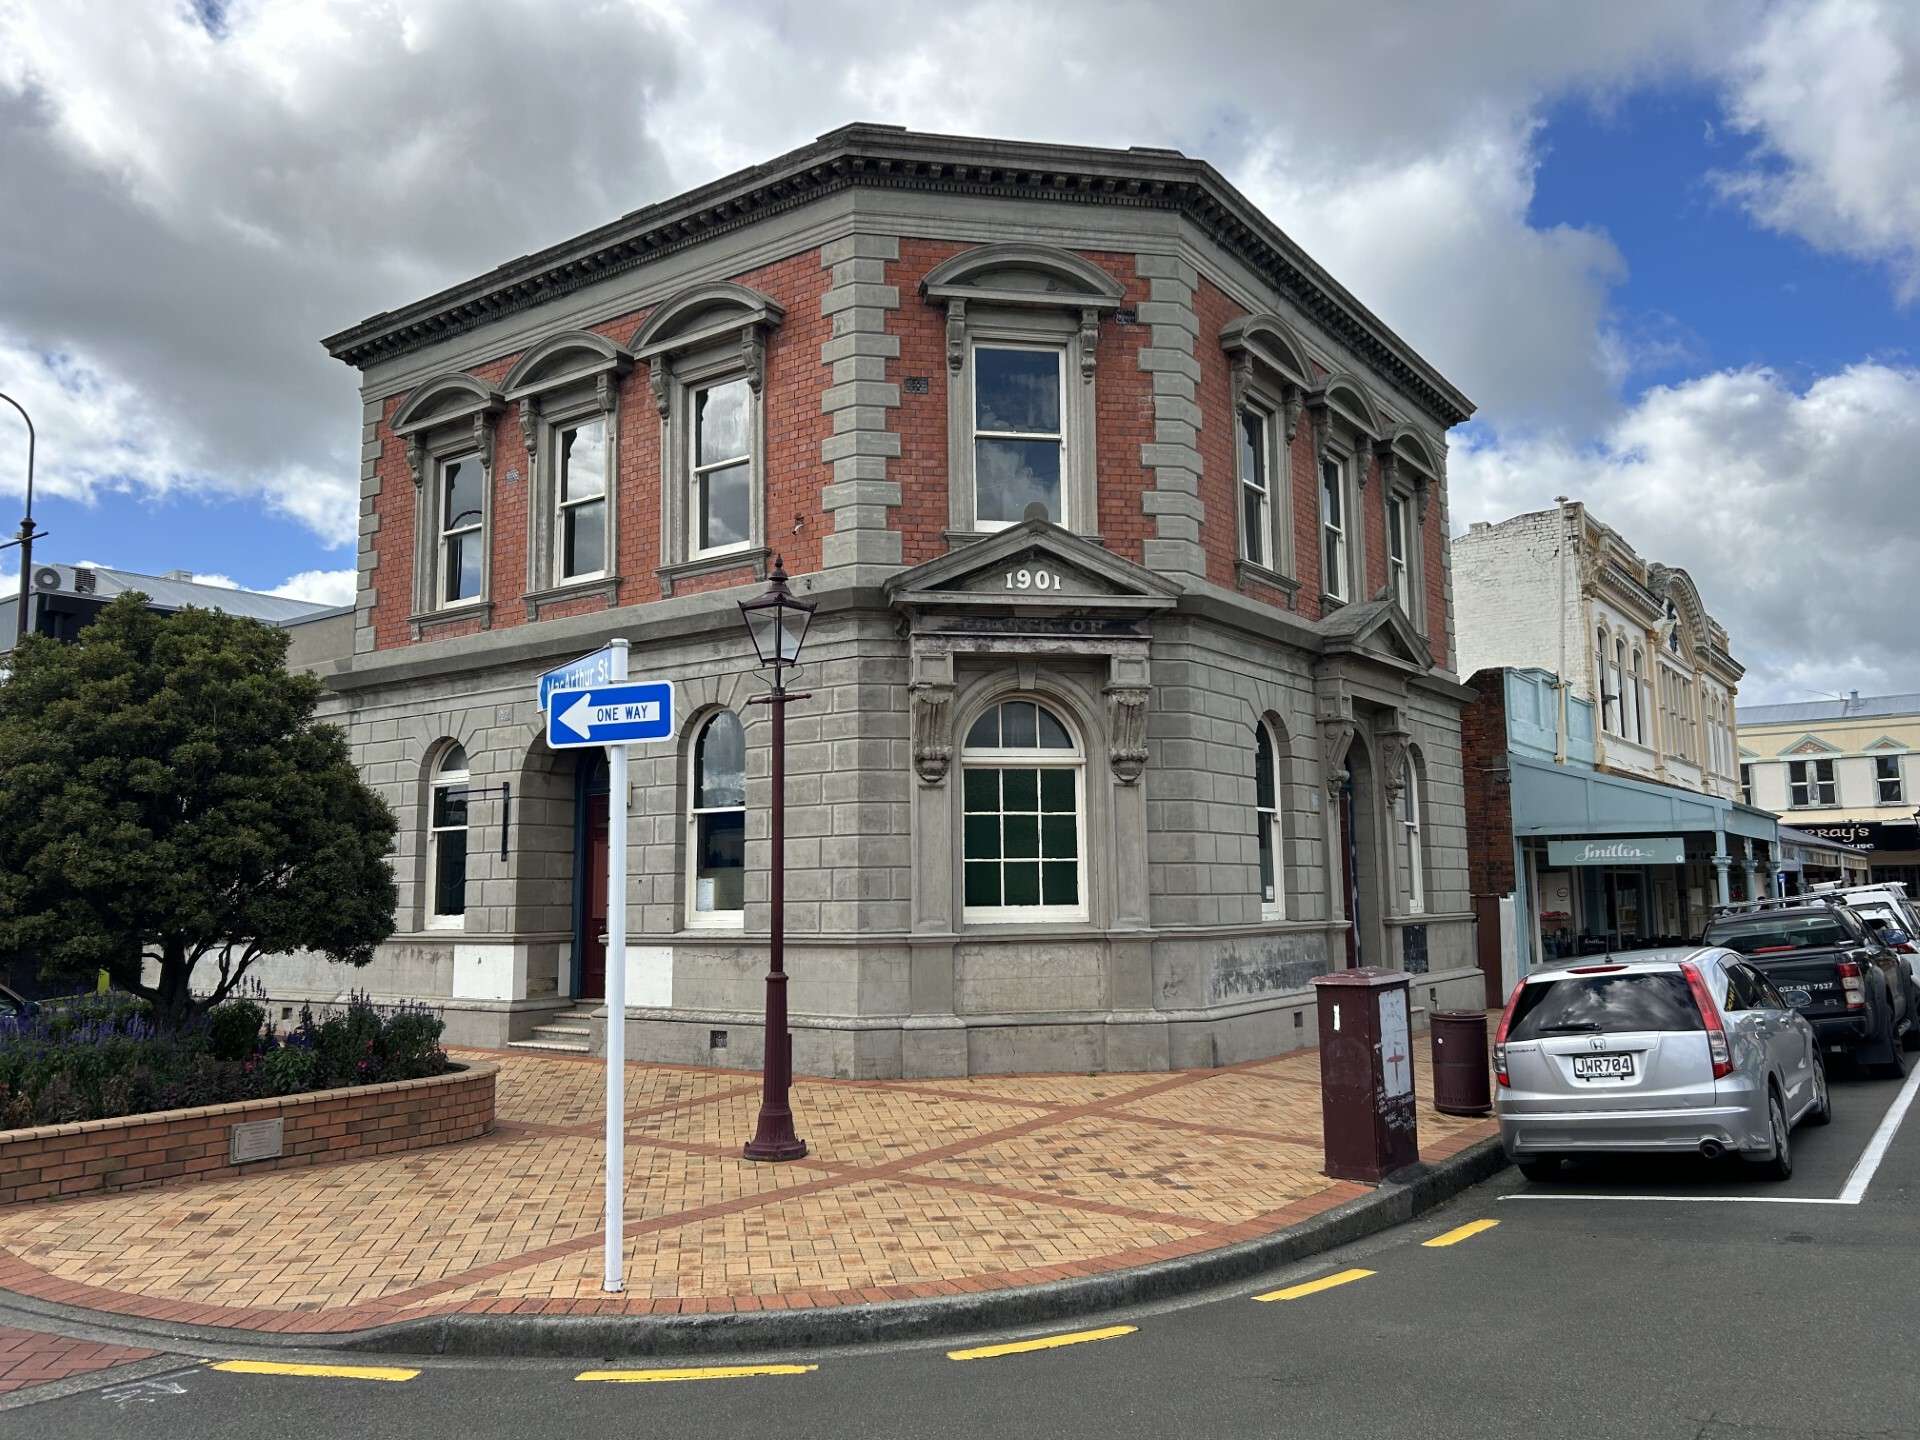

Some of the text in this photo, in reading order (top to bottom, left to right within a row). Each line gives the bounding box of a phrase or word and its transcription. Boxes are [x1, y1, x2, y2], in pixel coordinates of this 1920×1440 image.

[1005, 569, 1063, 590] 1901
[598, 658, 609, 682] St
[597, 705, 648, 722] ONE WAY
[1577, 1057, 1630, 1072] JWR704
